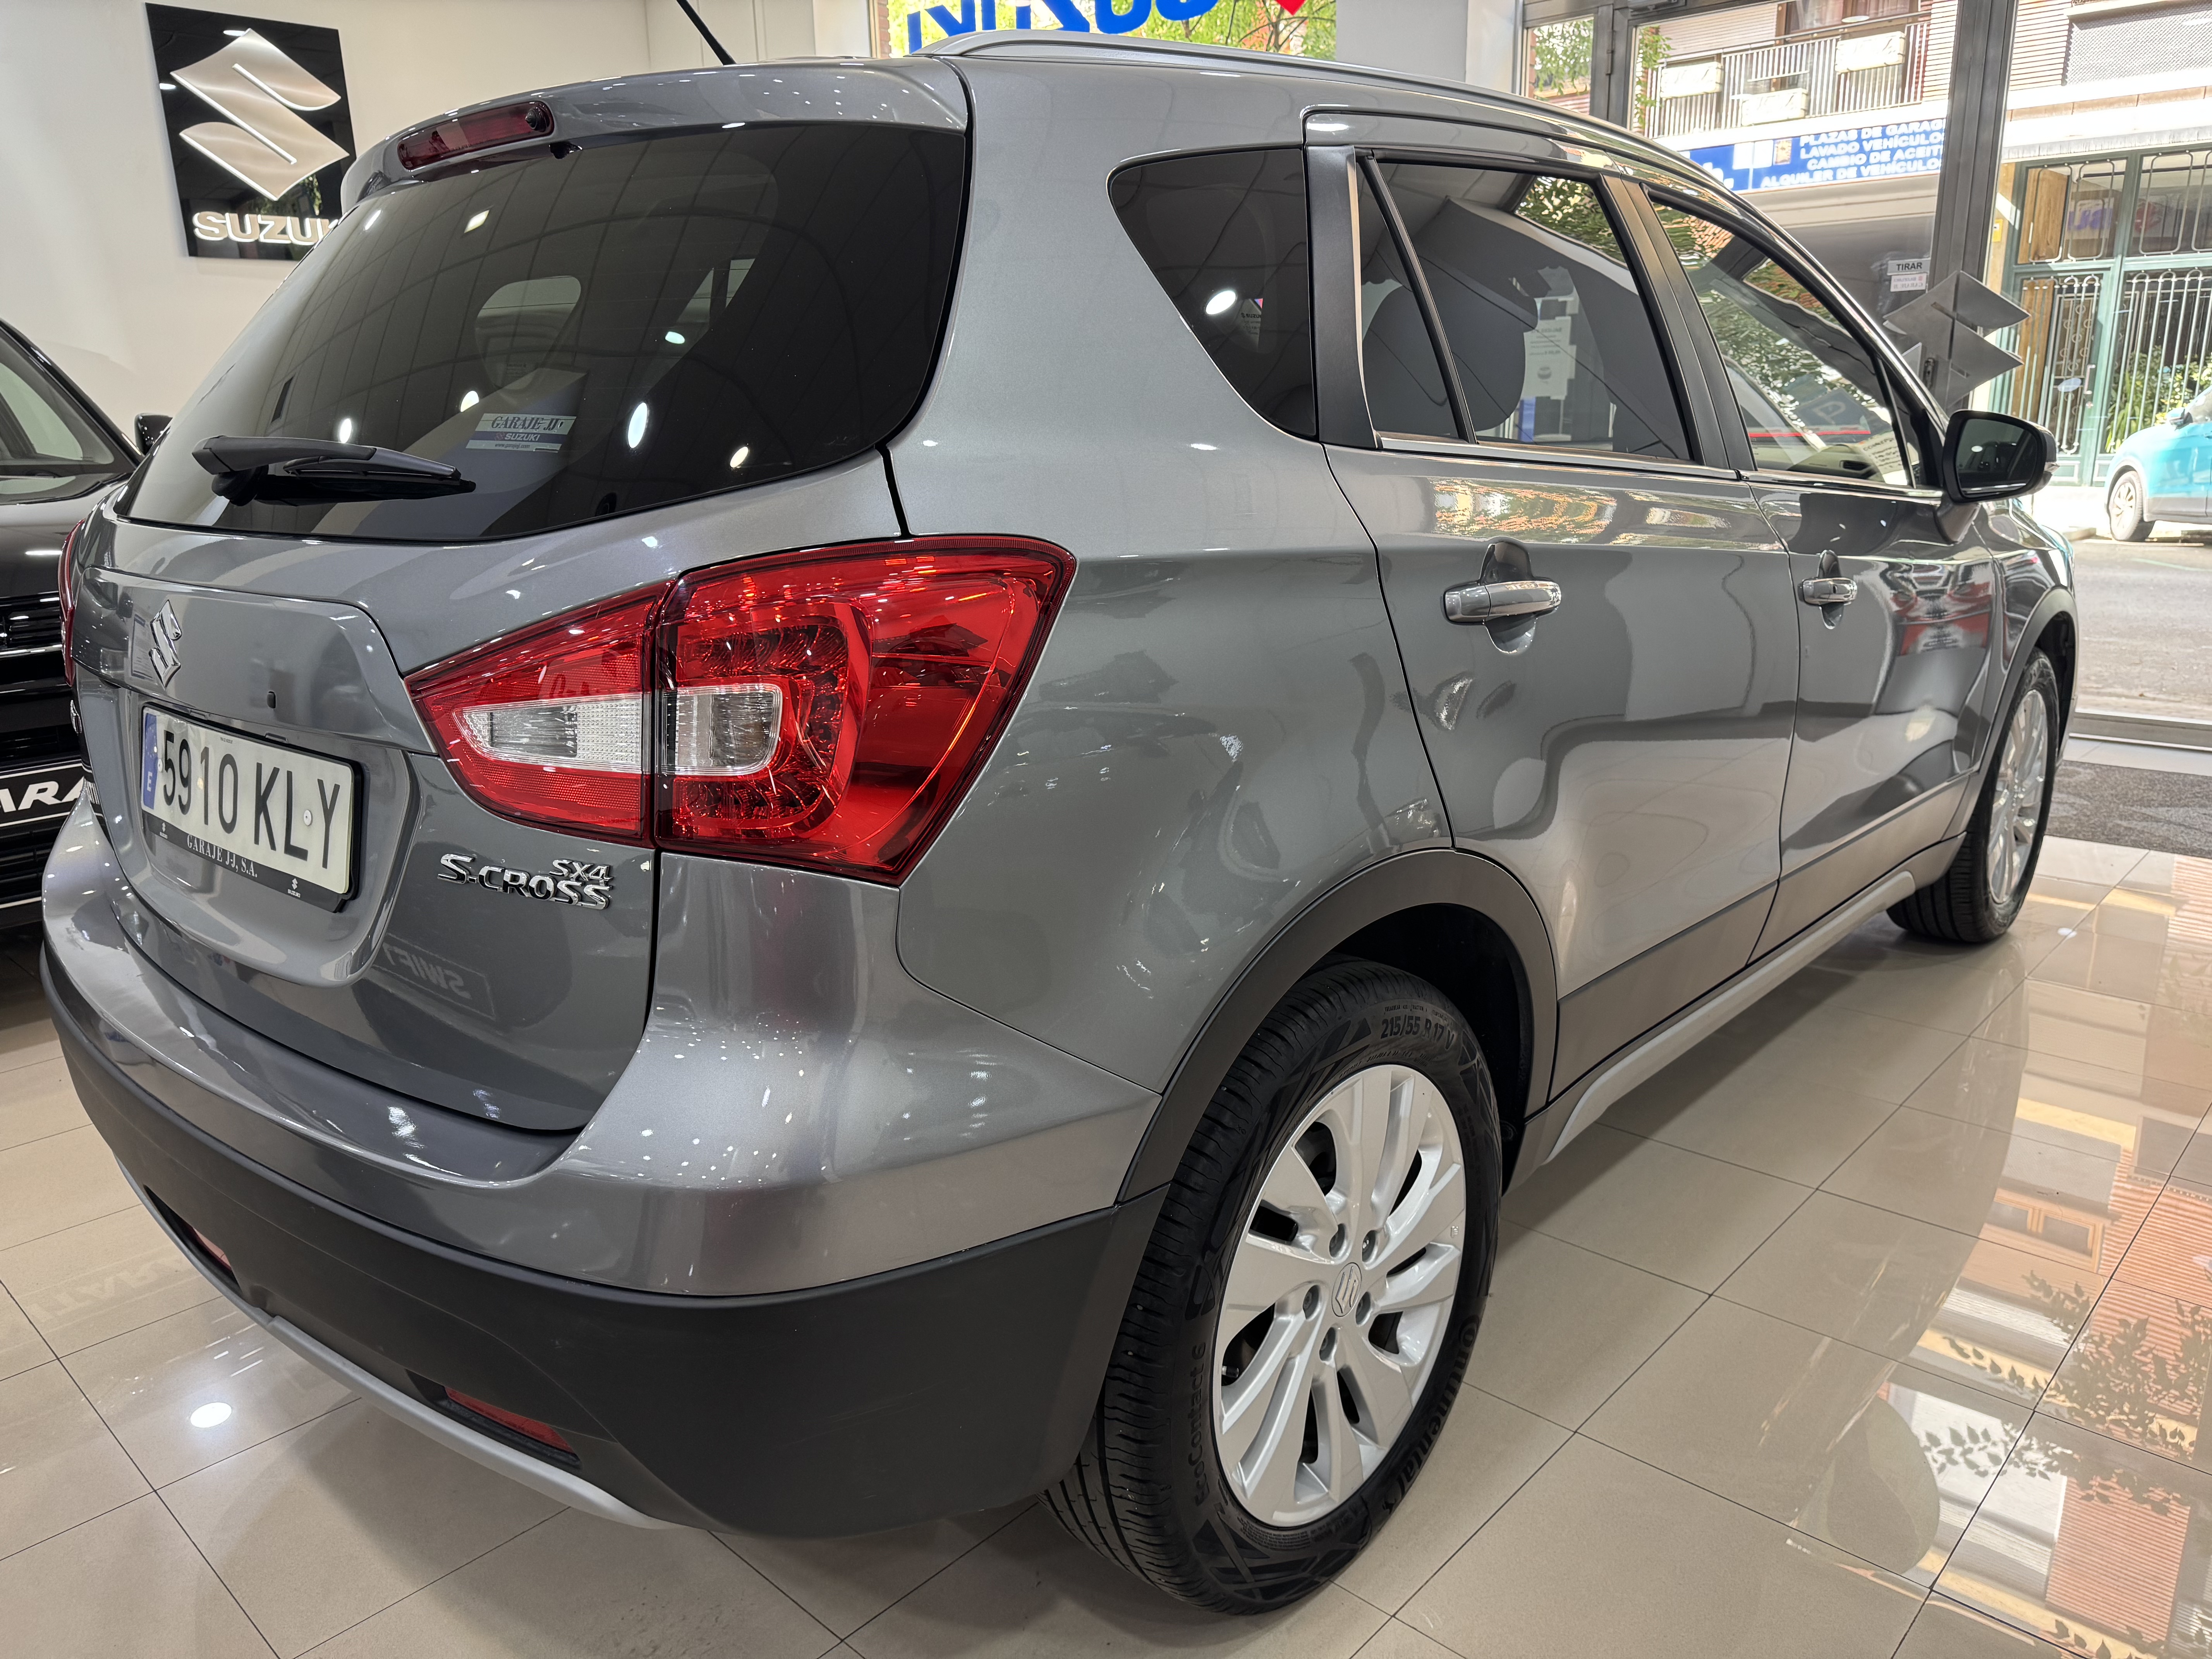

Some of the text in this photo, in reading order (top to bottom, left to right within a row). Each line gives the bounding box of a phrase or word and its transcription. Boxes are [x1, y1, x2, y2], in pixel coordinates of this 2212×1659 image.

[1800, 129, 1858, 147] PLAZAS
[1861, 127, 1882, 139] DE
[1800, 142, 1860, 159] LAVADO
[1807, 153, 1867, 170] CAMBIO
[1869, 151, 1891, 164] DE
[1760, 169, 1833, 188] ALQUILER
[1836, 167, 1857, 180] DE
[1896, 262, 1922, 271] TIRAR
[491, 416, 544, 430] GARAJE
[147, 771, 153, 792] E
[163, 730, 340, 869] 5910 KLY
[187, 834, 223, 862] GARAJE
[241, 858, 258, 878] S.A.
[549, 859, 613, 882] SX4
[1380, 1014, 1455, 1050] 215/55 R 17 V
[1188, 1341, 1210, 1506] EcoContact 6
